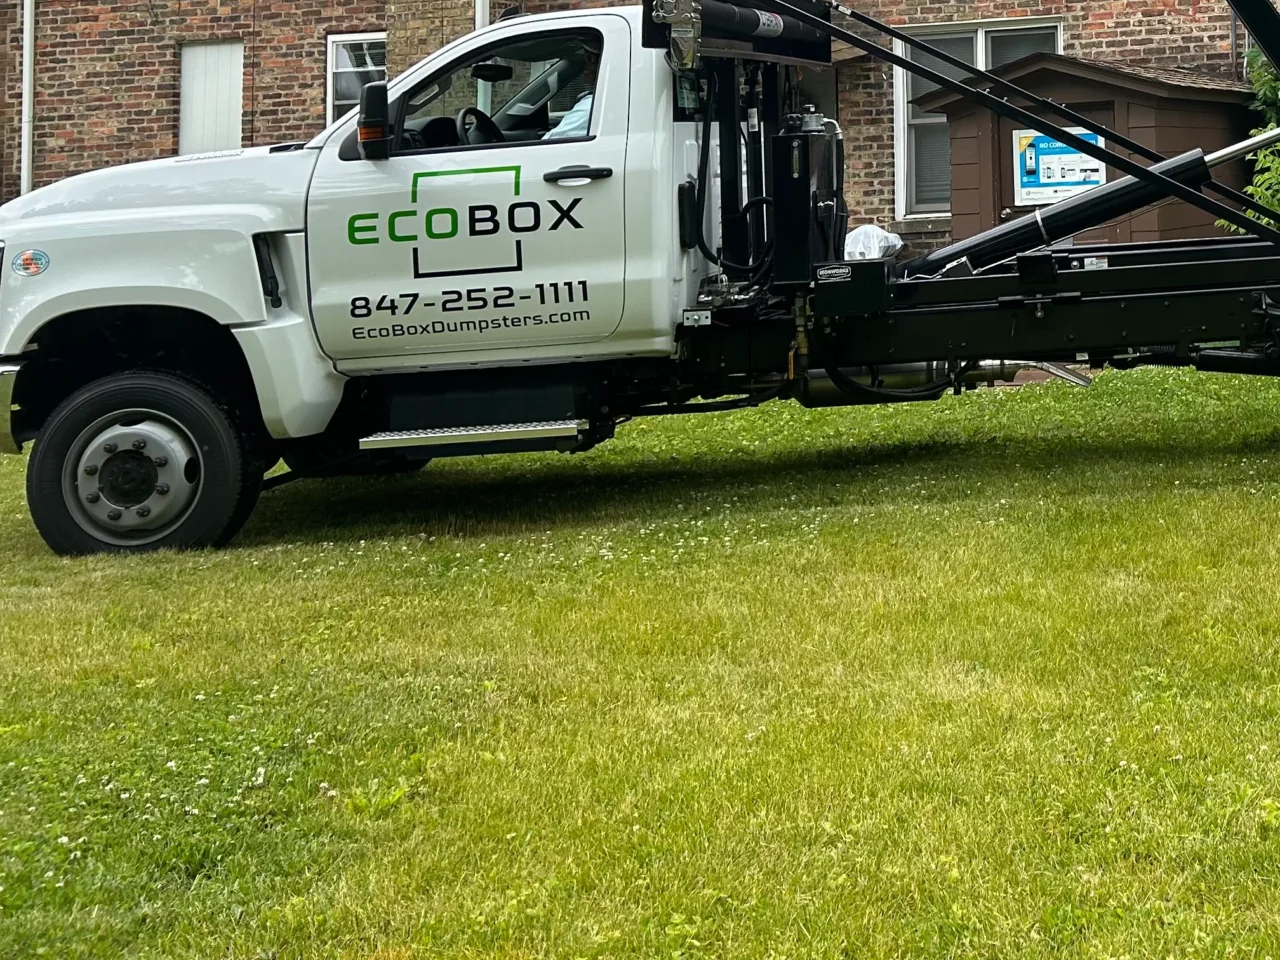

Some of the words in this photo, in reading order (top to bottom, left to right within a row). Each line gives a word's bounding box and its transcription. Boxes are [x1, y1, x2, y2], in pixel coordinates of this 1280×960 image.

[347, 197, 585, 245] ECOBOX
[350, 280, 589, 318] 847-252-1111
[352, 309, 591, 340] EcoBoxDumpsters.com
